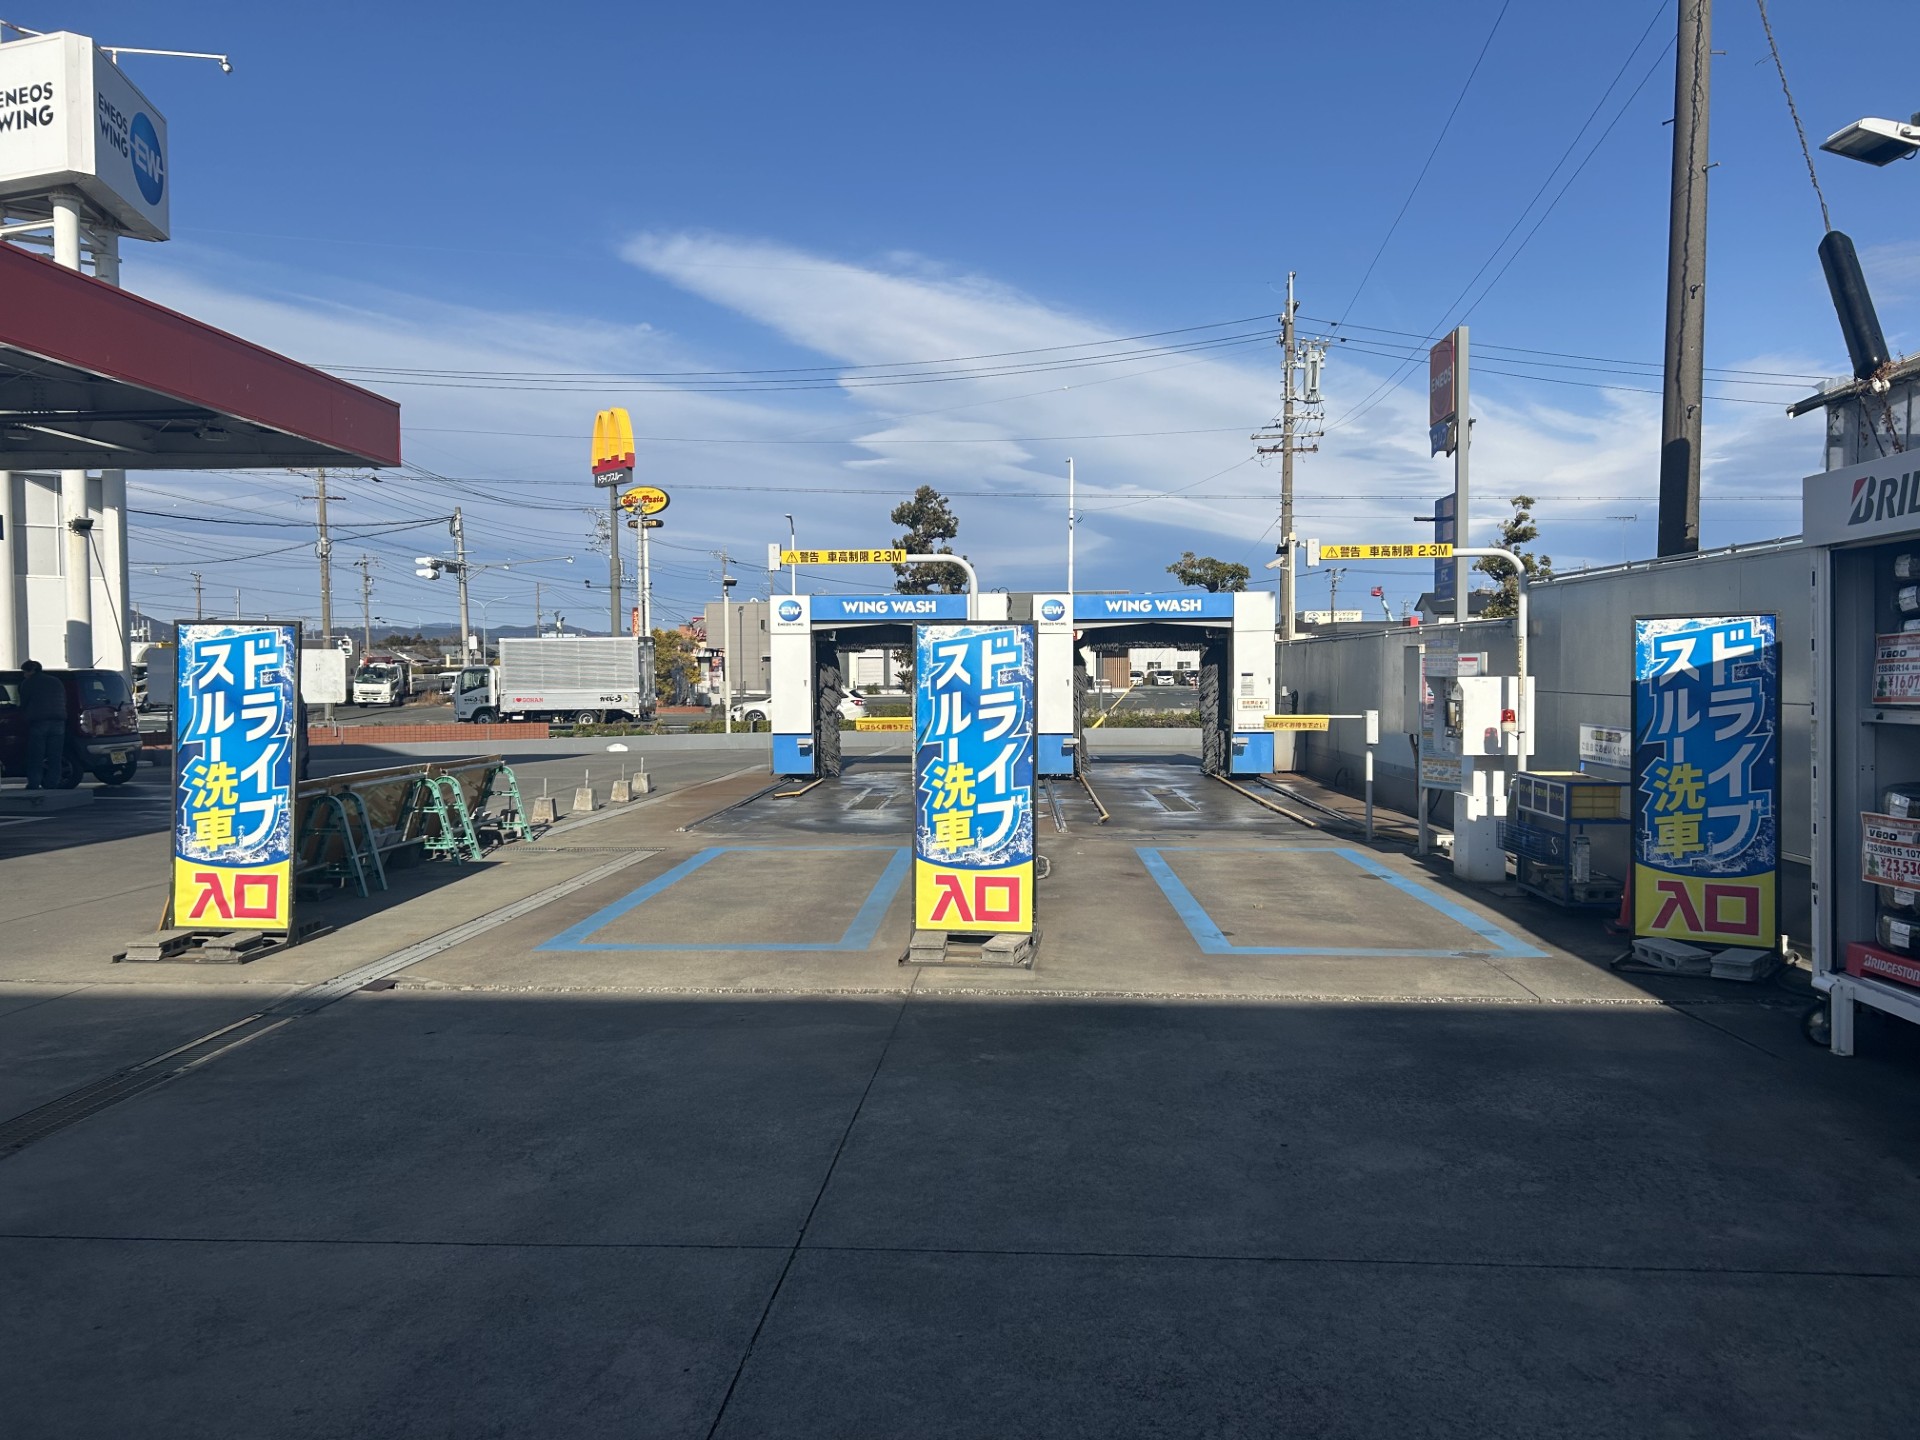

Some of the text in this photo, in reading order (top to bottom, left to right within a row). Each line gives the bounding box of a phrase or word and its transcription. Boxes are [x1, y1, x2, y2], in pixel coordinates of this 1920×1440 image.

[98, 91, 128, 134] ENEOS
[99, 114, 129, 159] WING
[1431, 367, 1452, 392] ENEOS
[800, 551, 902, 563] 警告 車高制限 2.3M
[1340, 545, 1448, 558] 警告 車高制限 2.3M
[842, 600, 937, 614] WING WASH
[1105, 599, 1202, 613] WING WASH
[192, 644, 239, 851] スルー洗車
[239, 638, 282, 848] ドライブ
[977, 638, 1022, 849] ドライブ
[1267, 721, 1326, 729] しばらくお待ち下さい
[1654, 637, 1706, 859] スルー洗車
[1707, 628, 1762, 856] ドライブ
[932, 645, 976, 854] スルー洗車
[1869, 829, 1897, 841] V600
[189, 872, 279, 921] 入口
[930, 874, 1020, 923] 入口
[1651, 880, 1760, 937] 入口
